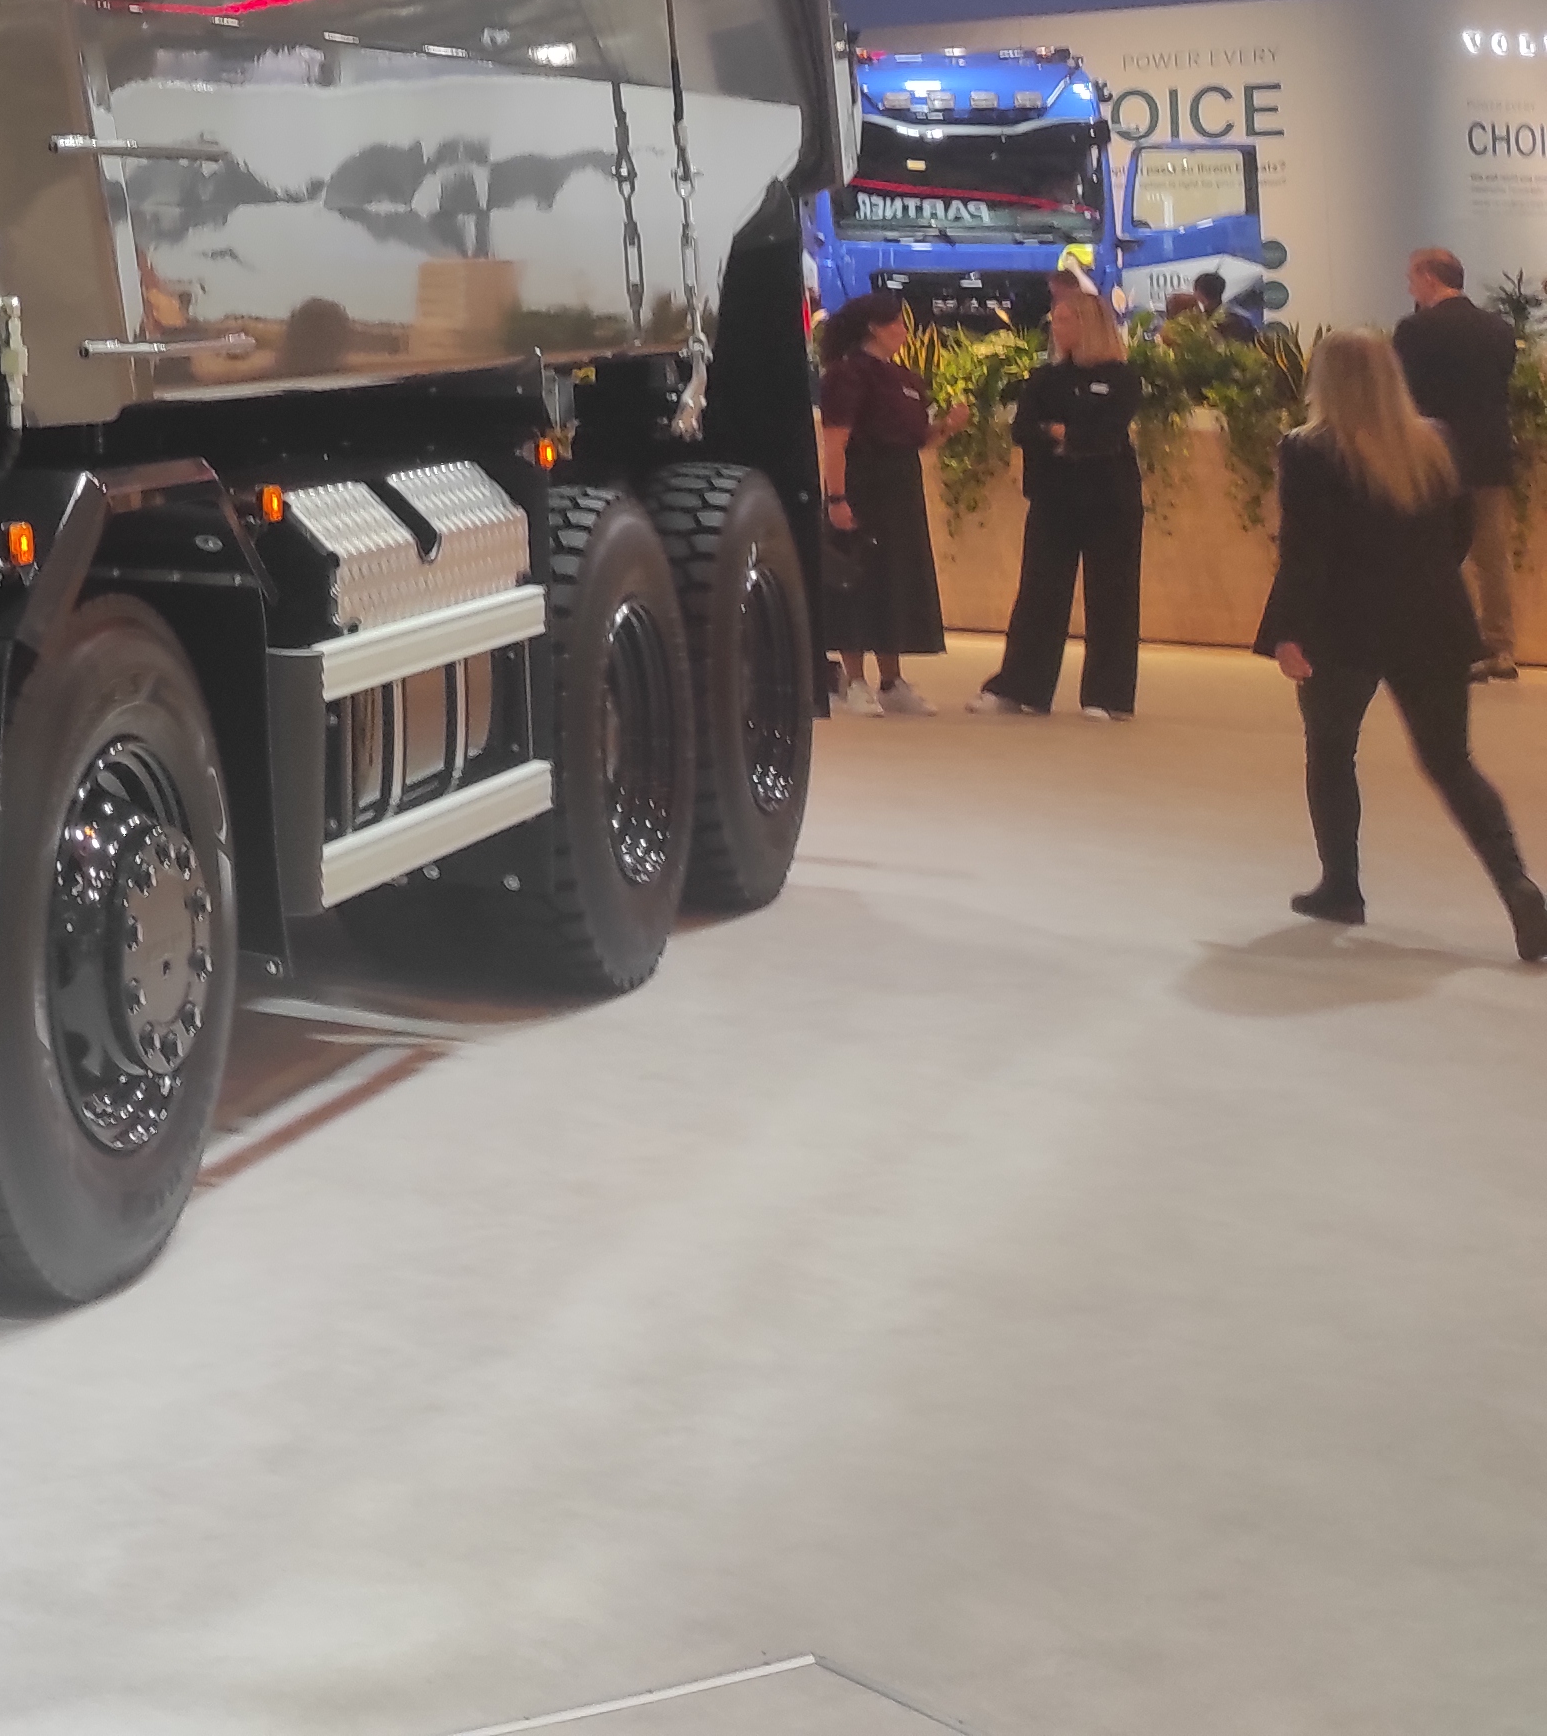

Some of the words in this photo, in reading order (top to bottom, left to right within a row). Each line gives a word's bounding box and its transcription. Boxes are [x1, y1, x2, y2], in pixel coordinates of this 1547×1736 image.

[1462, 30, 1547, 57] VOL
[1122, 50, 1201, 72] POWER
[1208, 47, 1279, 68] EVERY
[1111, 82, 1285, 142] OICE
[1468, 121, 1547, 157] CHOI
